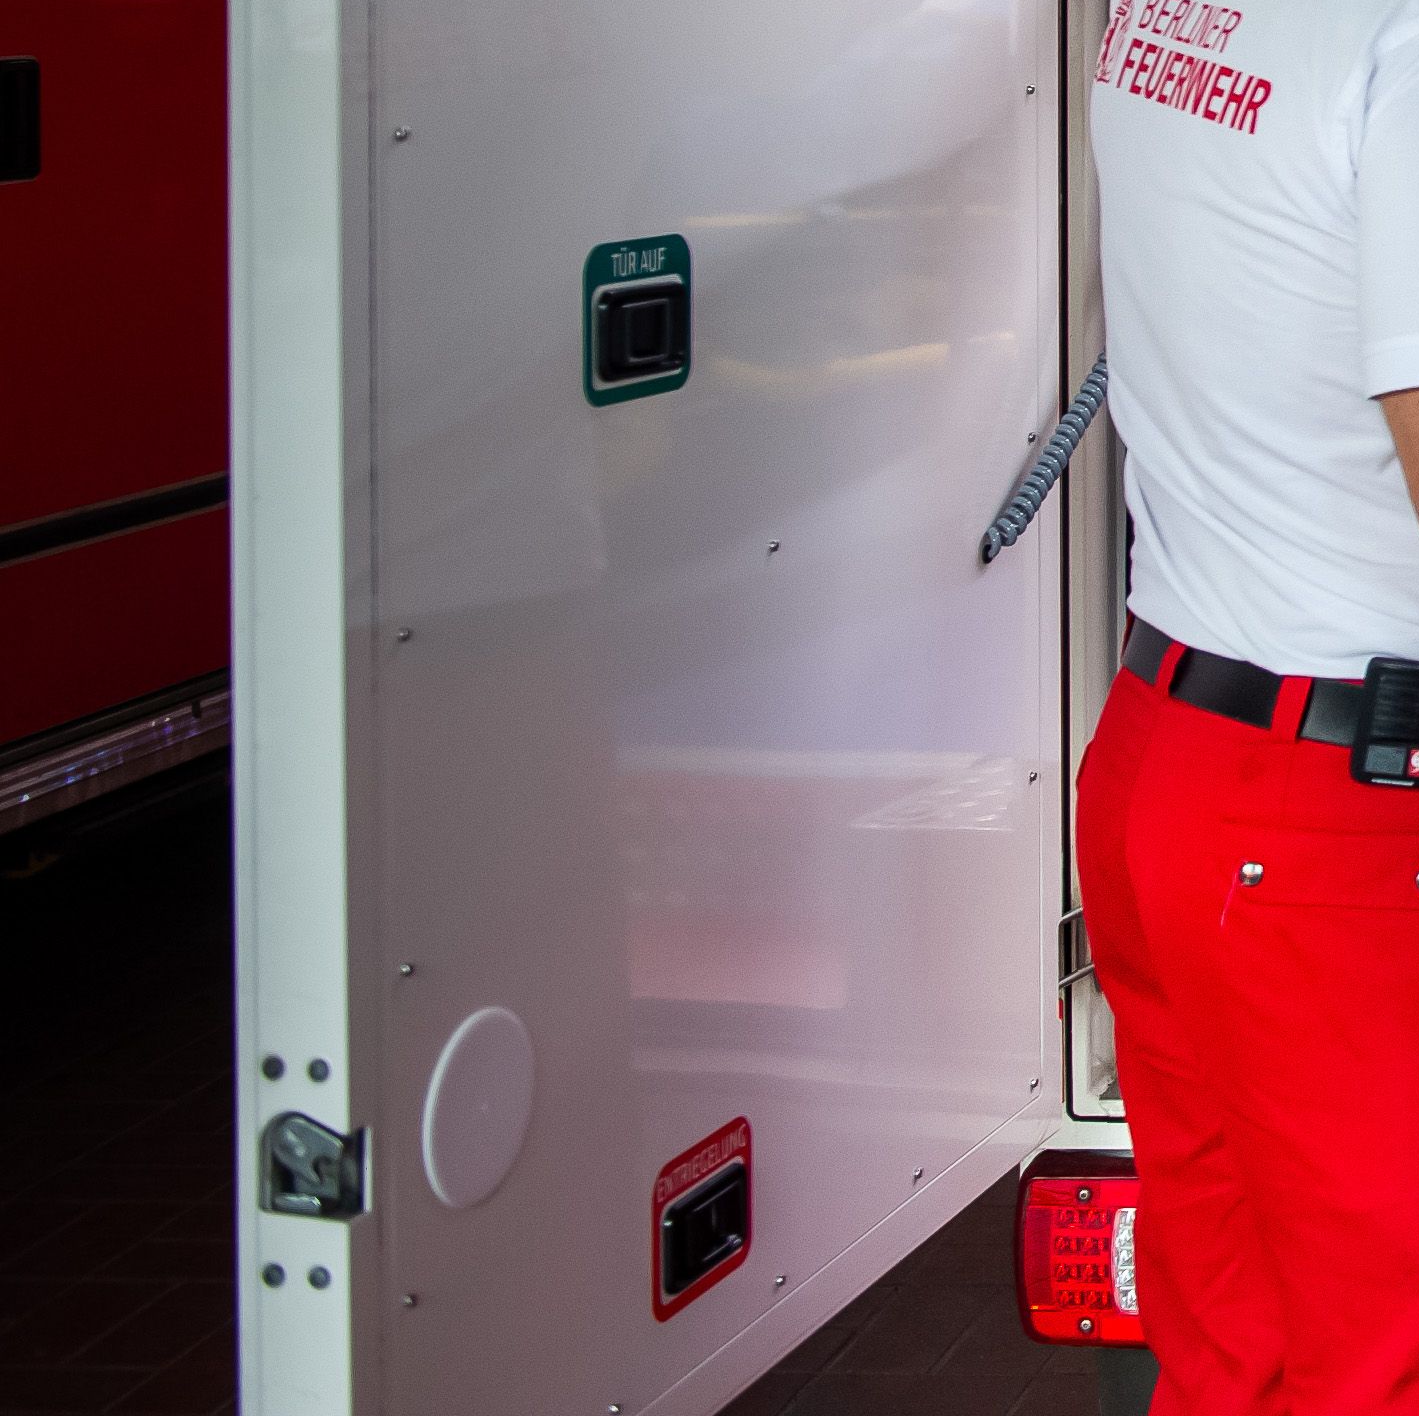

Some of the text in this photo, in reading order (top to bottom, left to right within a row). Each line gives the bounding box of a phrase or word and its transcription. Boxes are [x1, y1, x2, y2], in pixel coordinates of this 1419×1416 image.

[1116, 38, 1273, 135] FEUERWEHR
[610, 246, 667, 278] TÜR AUF
